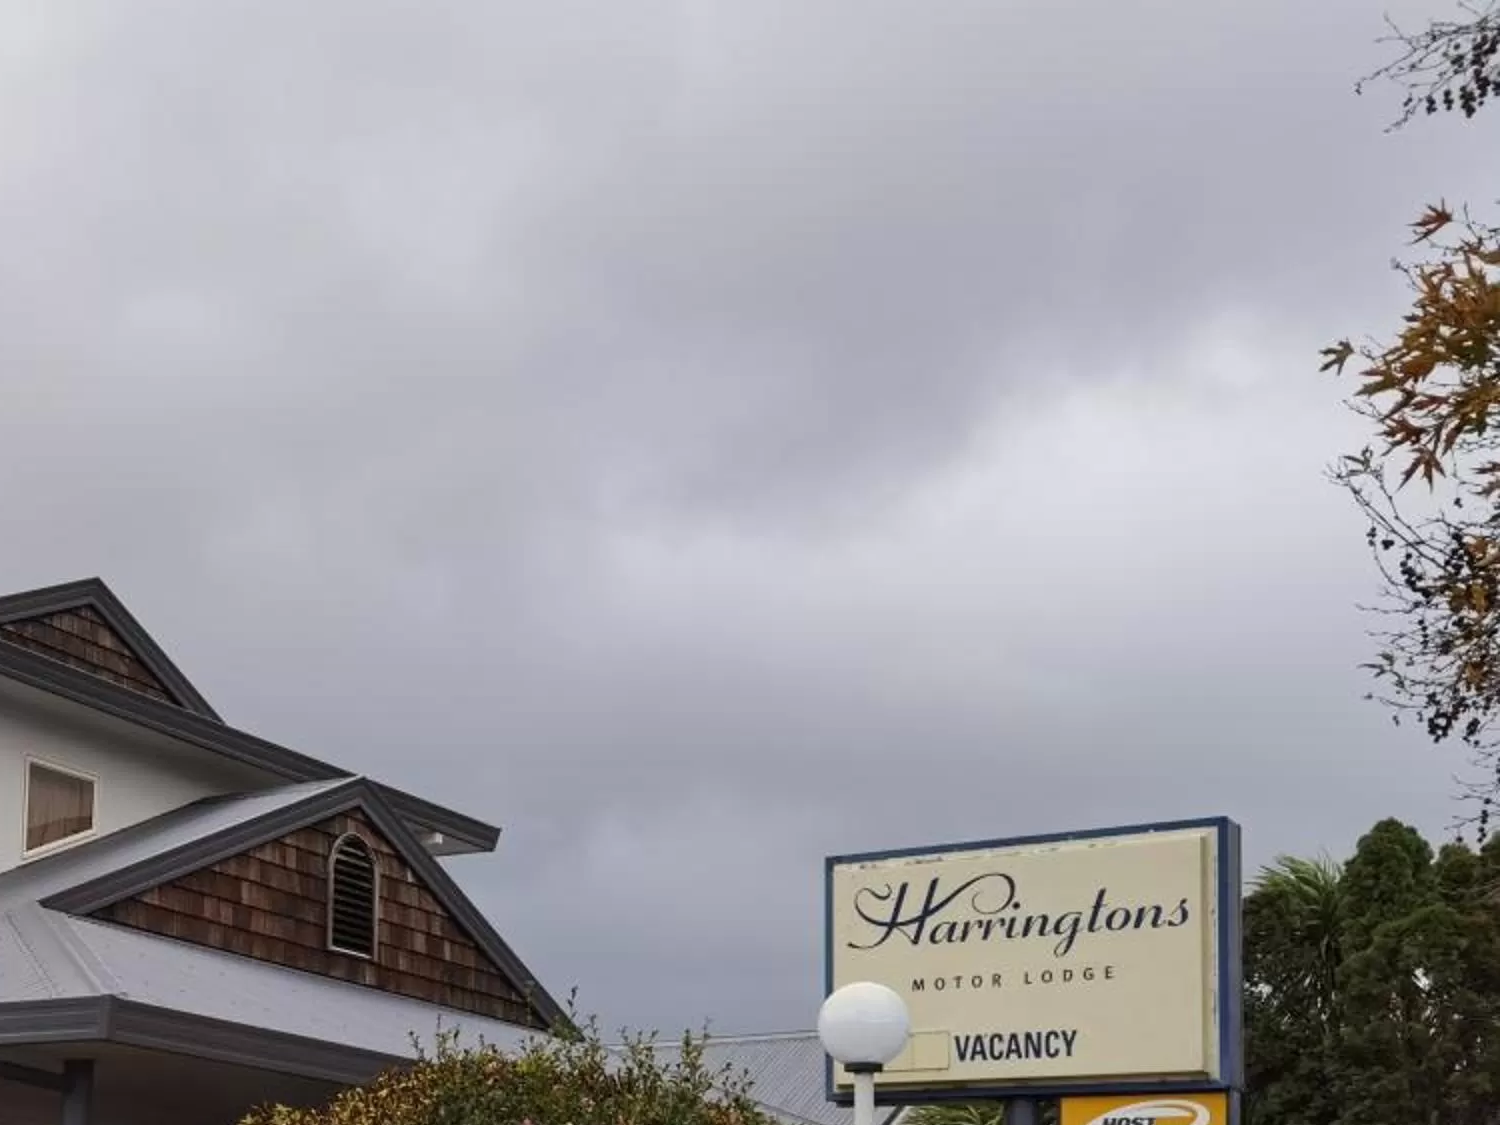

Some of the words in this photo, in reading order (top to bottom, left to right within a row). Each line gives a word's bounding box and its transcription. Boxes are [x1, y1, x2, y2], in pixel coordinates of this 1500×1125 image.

[847, 872, 1190, 958] Harringtons
[911, 972, 1003, 993] MOTOR
[1024, 965, 1116, 986] LODGE
[953, 1029, 1078, 1063] VACANCY
